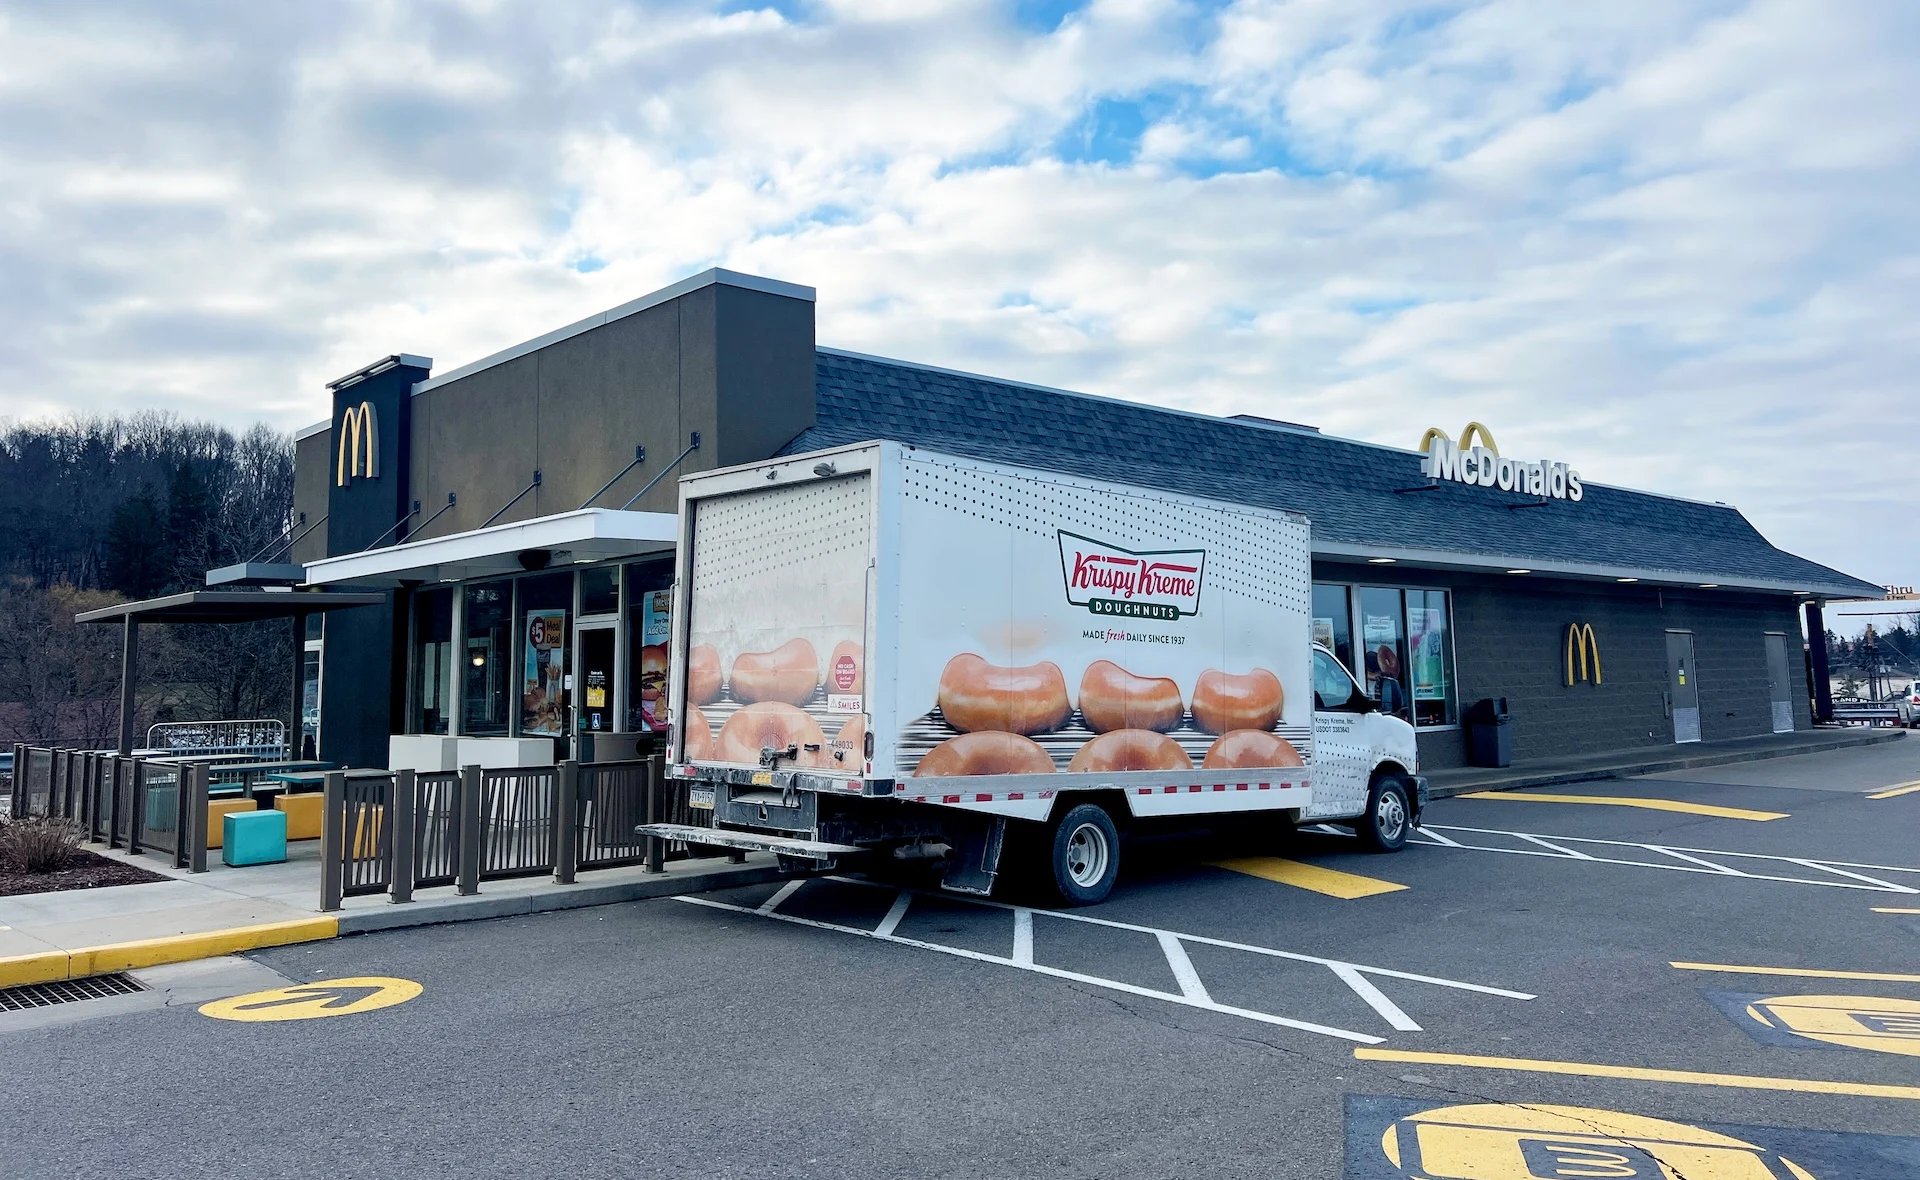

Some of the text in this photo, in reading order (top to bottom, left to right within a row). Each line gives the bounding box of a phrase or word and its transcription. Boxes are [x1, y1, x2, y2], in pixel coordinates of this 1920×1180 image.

[1427, 437, 1583, 502] McDonald's
[1072, 552, 1197, 599] Krispy Kreme
[1095, 601, 1174, 618] DOUGHNUTS
[532, 622, 544, 643] $5
[547, 620, 562, 631] Meal
[547, 632, 561, 643] Deal
[1083, 628, 1185, 645] MADE fresh DAILY SINCE 1937
[838, 701, 860, 709] SMILES
[1315, 717, 1329, 725] Krispy
